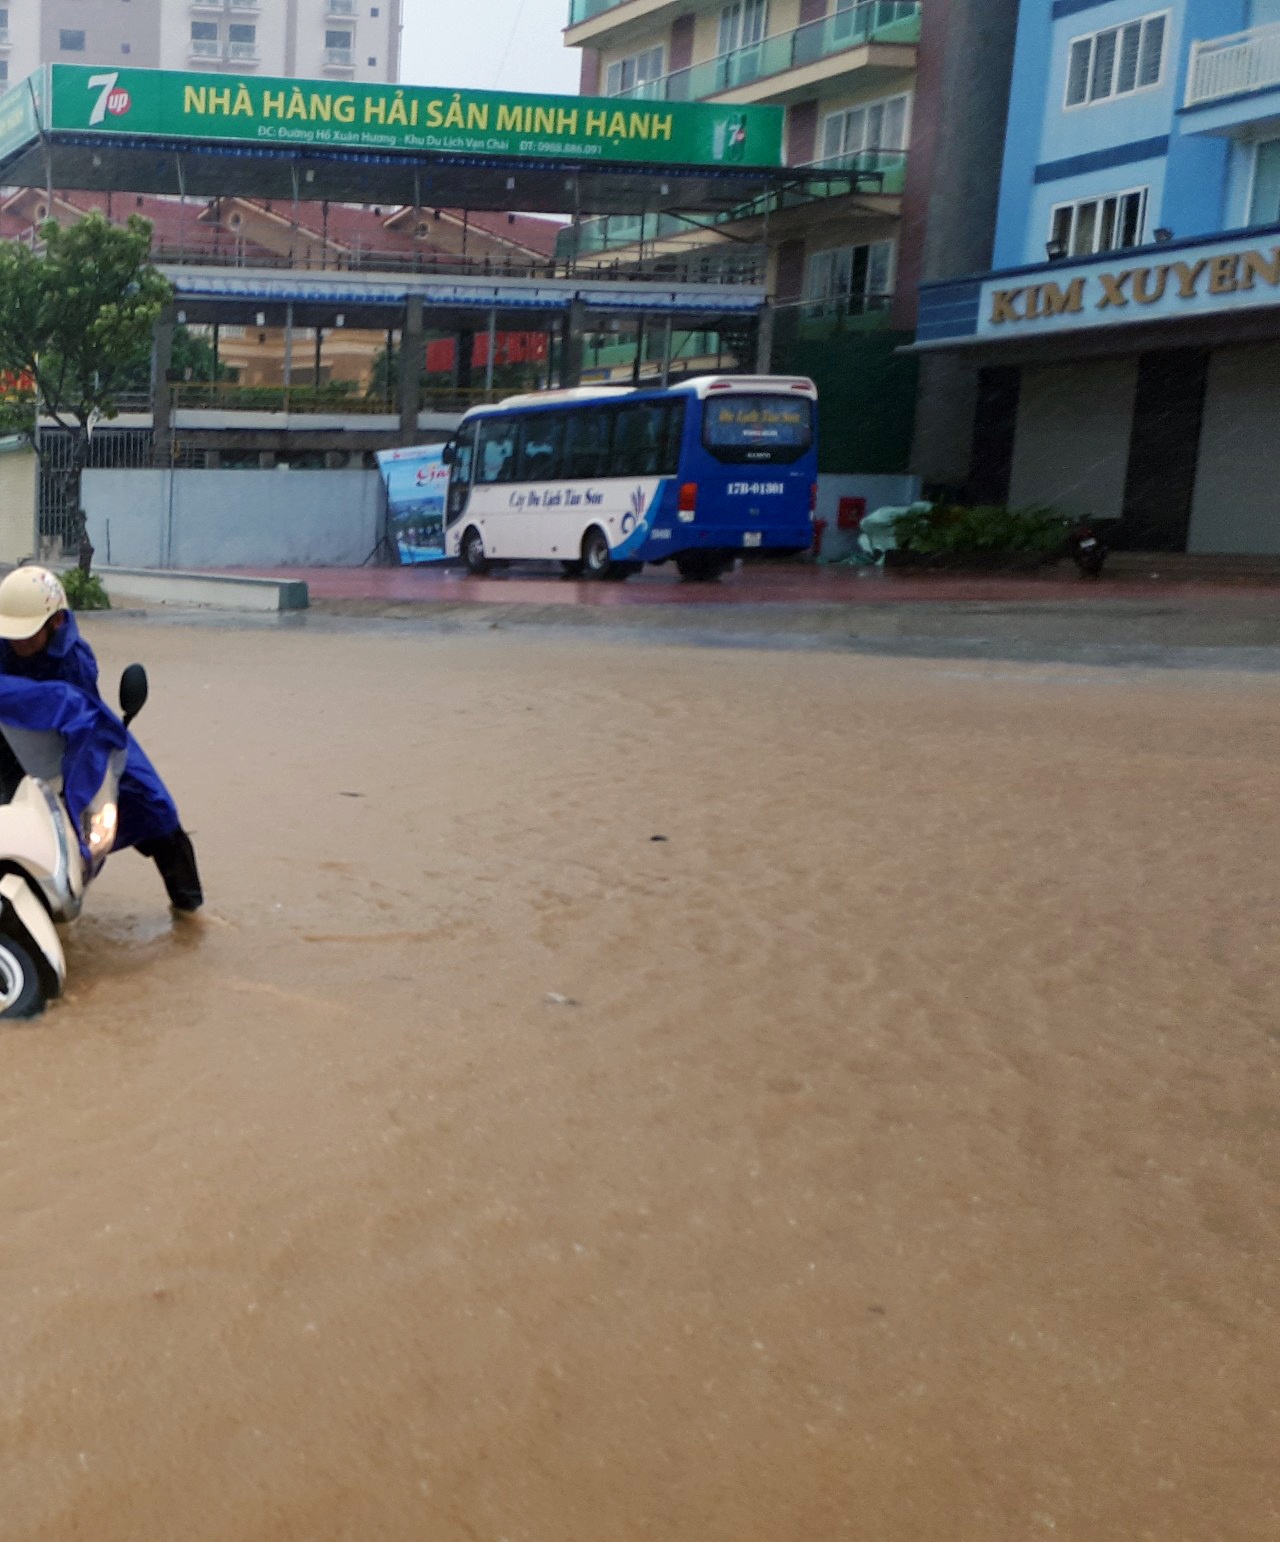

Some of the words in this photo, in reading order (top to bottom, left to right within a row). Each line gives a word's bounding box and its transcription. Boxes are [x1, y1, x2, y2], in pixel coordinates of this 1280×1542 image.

[183, 83, 254, 117] NHÀ
[263, 86, 356, 123] HÀNG
[364, 89, 418, 127] HẢI
[425, 93, 489, 131] SẢN
[496, 104, 579, 136] MINH
[585, 110, 673, 147] HẠNH
[990, 276, 1086, 325] KIM
